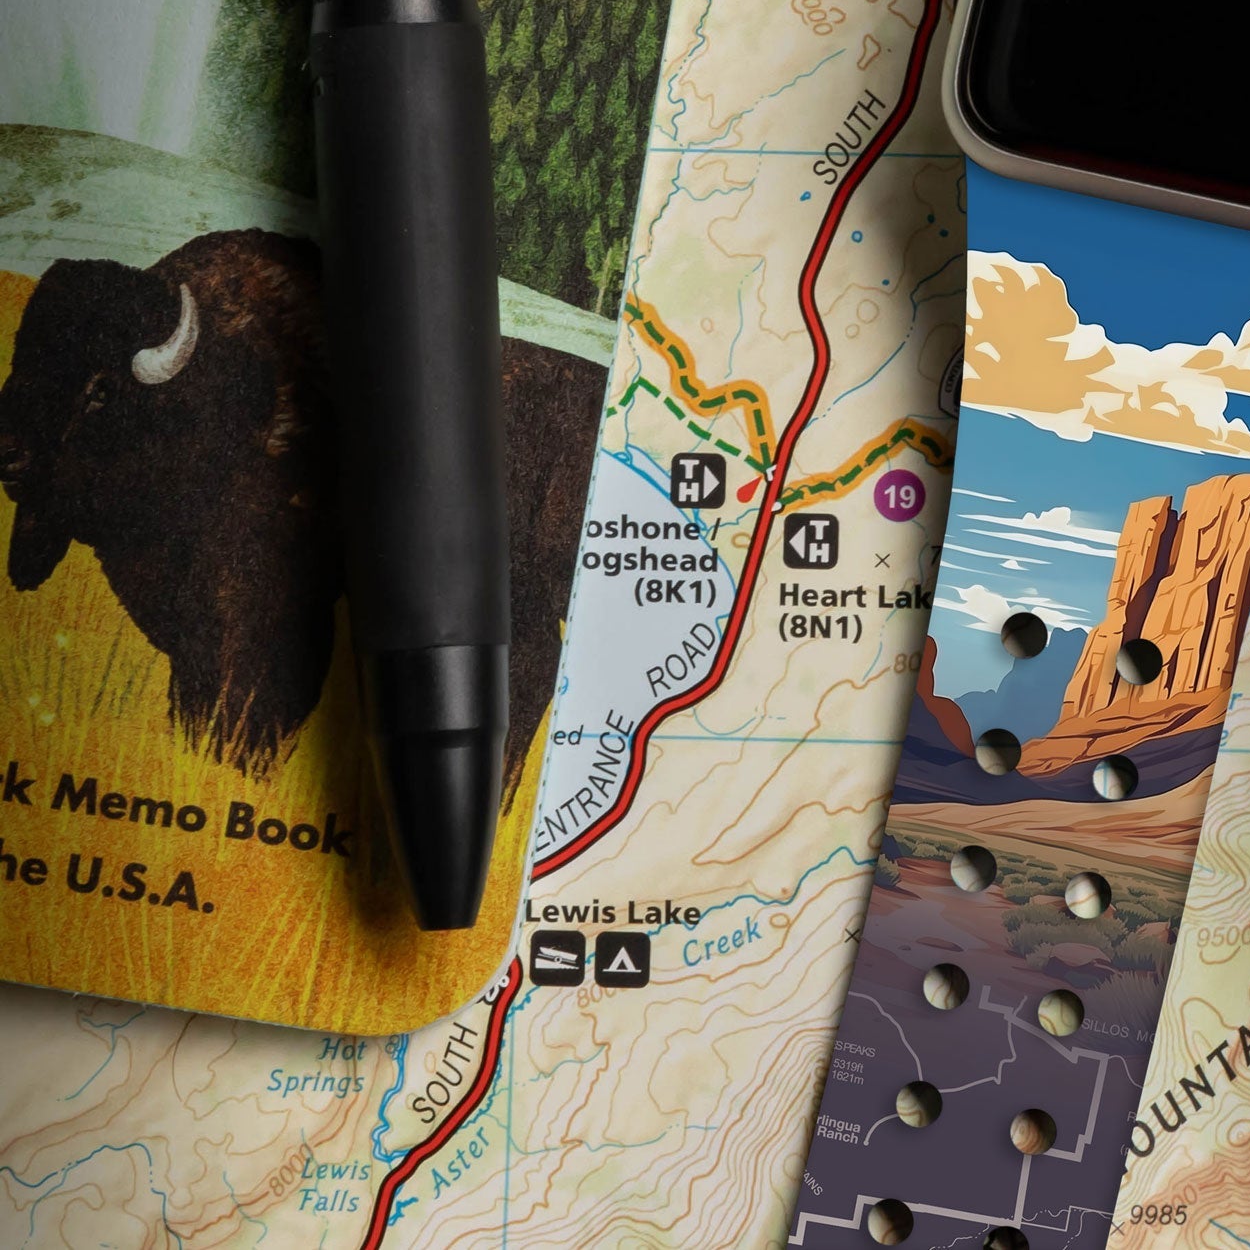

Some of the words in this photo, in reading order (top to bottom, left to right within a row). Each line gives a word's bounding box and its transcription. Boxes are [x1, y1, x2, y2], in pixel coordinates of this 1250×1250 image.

[813, 88, 887, 187] SOUTH
[884, 485, 915, 509] 19
[634, 578, 717, 606] (8K1)
[779, 584, 866, 608] Heart
[778, 614, 863, 643] (8N1)
[645, 622, 716, 698] ROAD
[50, 772, 208, 833] Memo
[224, 800, 353, 858] Book
[65, 858, 215, 917] U.S.A.
[525, 900, 616, 924] Lewis
[627, 900, 701, 925] Lake
[682, 916, 763, 967] Creek
[317, 1038, 368, 1063] Hot
[266, 1070, 365, 1097] Springs
[411, 1022, 480, 1125] SOUTH
[300, 1158, 371, 1182] Lewis
[299, 1189, 361, 1214] Falls
[1130, 1204, 1188, 1226] 9985
